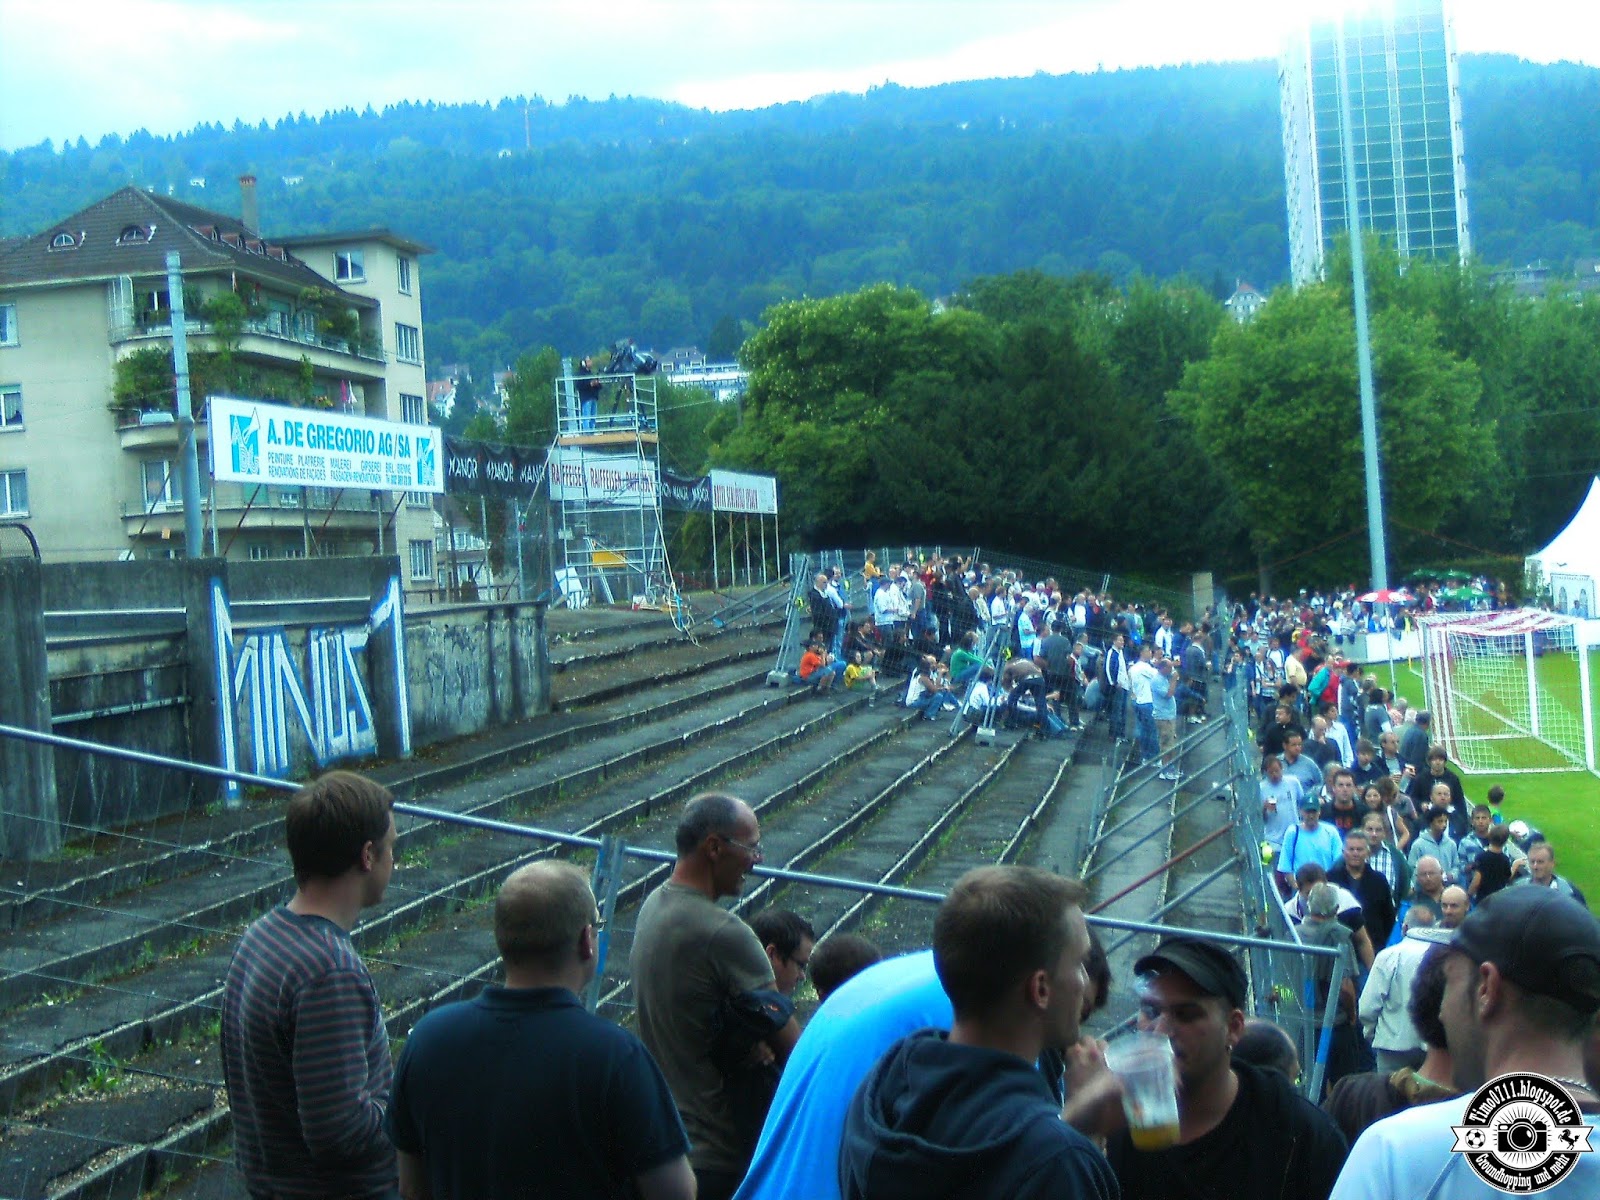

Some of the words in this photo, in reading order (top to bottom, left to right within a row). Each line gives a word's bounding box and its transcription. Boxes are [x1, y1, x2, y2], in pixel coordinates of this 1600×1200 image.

[267, 418, 282, 445] A.
[284, 420, 303, 448] DE
[306, 422, 375, 455] GREGORIO
[268, 452, 293, 466] PEINTURE
[448, 456, 479, 479] MANOR
[486, 460, 514, 482] MANOR
[590, 467, 621, 491] RAIFFEISEN
